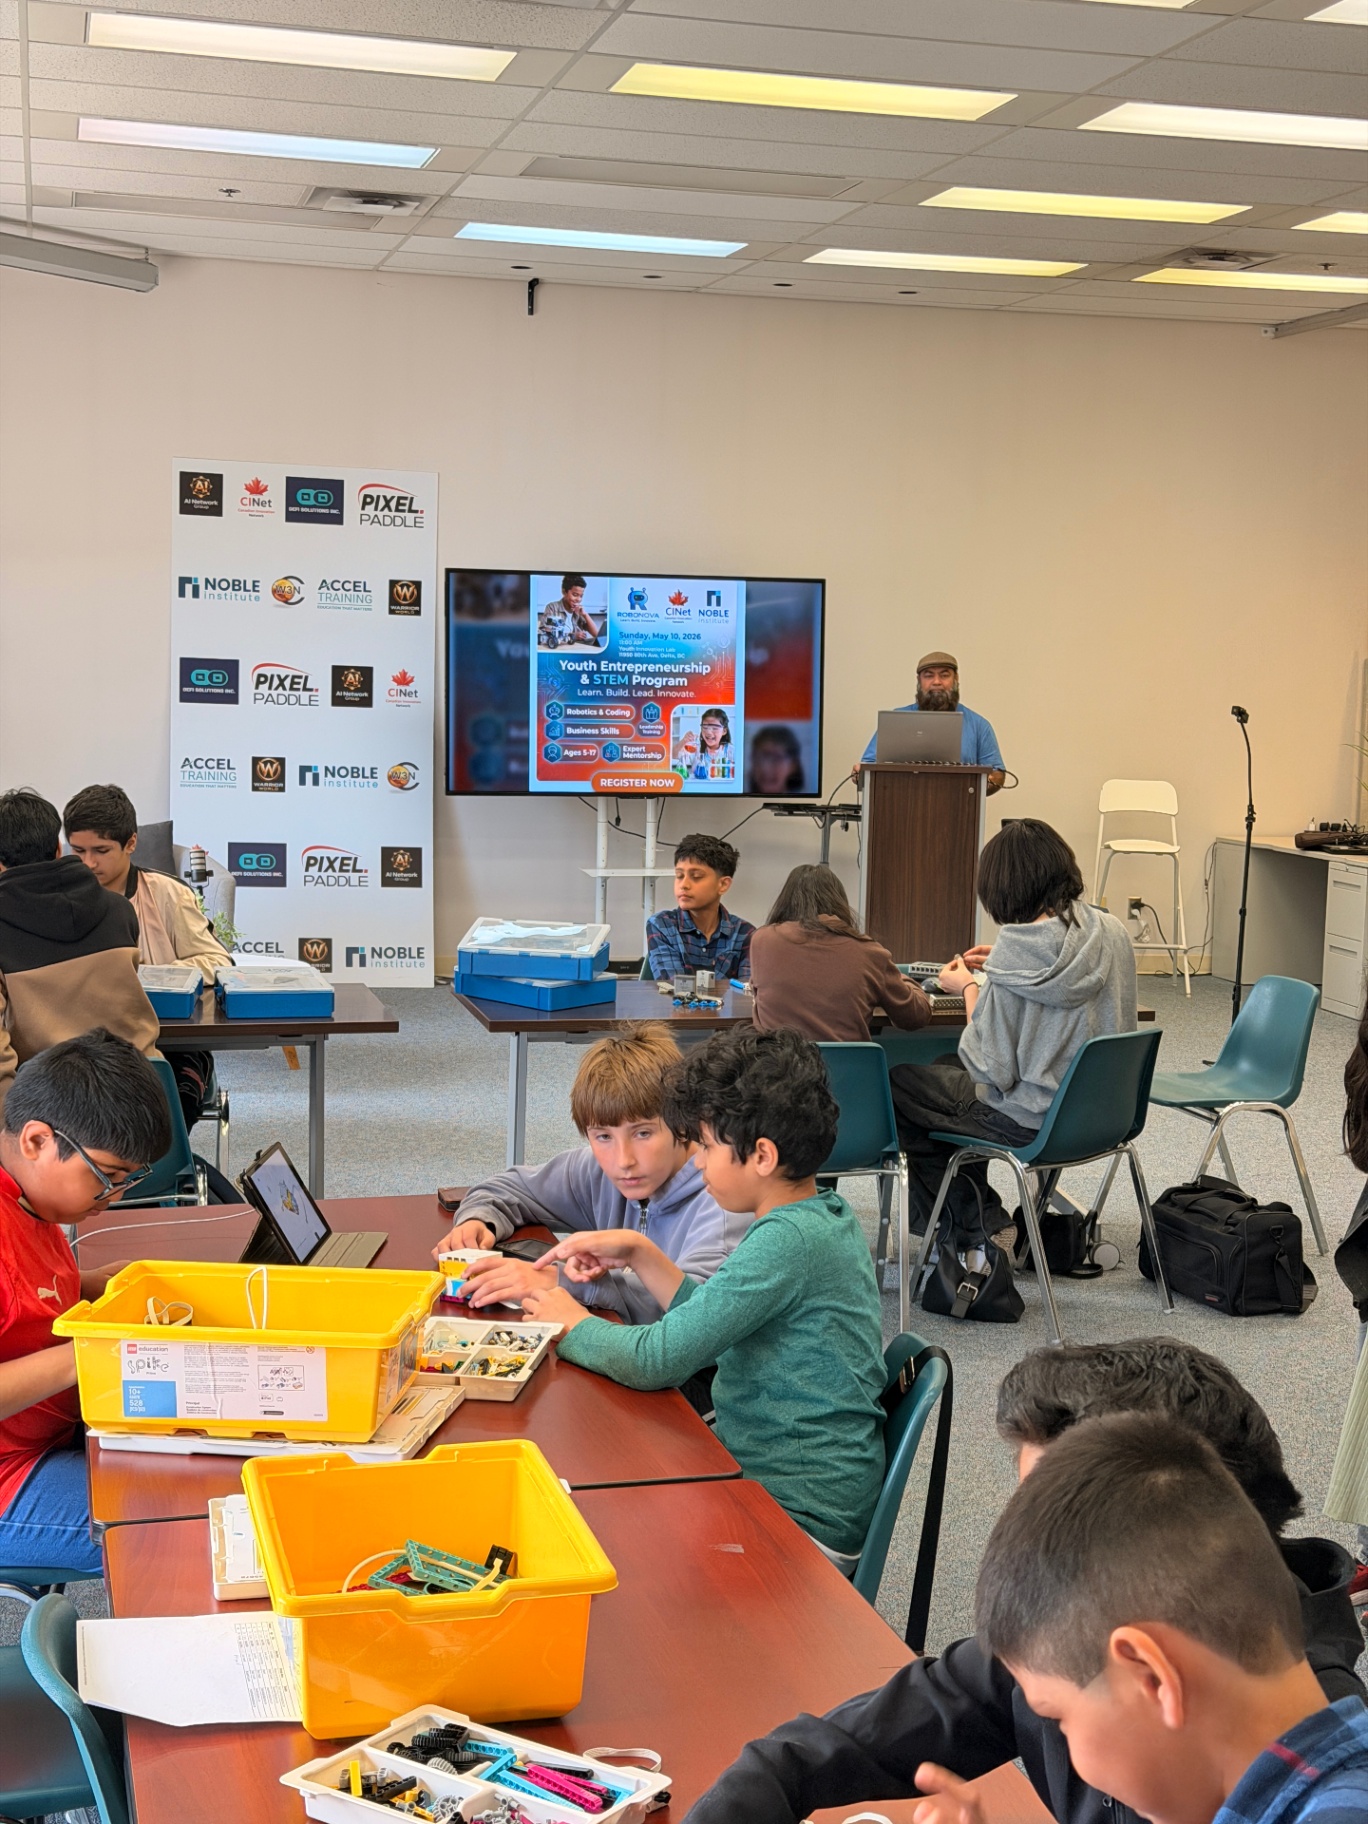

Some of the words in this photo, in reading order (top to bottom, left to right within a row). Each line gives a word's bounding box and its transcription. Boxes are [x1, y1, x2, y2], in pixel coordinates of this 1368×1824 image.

[240, 496, 272, 508] CINet
[360, 513, 424, 528] PADDLE
[204, 577, 260, 592] NOBLE
[318, 579, 372, 592] ACCEL
[204, 591, 260, 602] institute
[317, 592, 373, 604] TRAINING
[666, 607, 691, 616] CINet
[698, 609, 729, 617] NOBLE
[619, 632, 651, 640] Sunday,
[653, 633, 669, 641] May
[559, 660, 597, 671] Youth
[600, 660, 711, 675] Entrepreneurship
[580, 674, 590, 684] &
[593, 674, 629, 685] STEM
[632, 675, 687, 688] Program
[387, 688, 418, 698] CINet
[606, 689, 630, 697] Build.
[632, 689, 655, 697] Lead.
[657, 689, 696, 698] Innovate.
[253, 693, 319, 706] PADDLE
[567, 708, 598, 716] Robotics
[605, 708, 631, 718] Coding
[567, 727, 599, 735] Business
[600, 727, 620, 735] Skills
[564, 749, 581, 757] Ages
[623, 745, 645, 753] Expert
[623, 752, 662, 760] Mentorship
[180, 757, 236, 770] ACCEL
[180, 770, 237, 781] TRAINING
[324, 765, 378, 779] NOBLE
[324, 779, 378, 788] institute
[600, 778, 647, 787] REGISTER
[650, 779, 675, 787] NOW
[303, 875, 369, 887] PADDLE
[232, 941, 284, 953] ACCEL
[371, 946, 425, 959] NOBLE
[370, 959, 425, 968] institute
